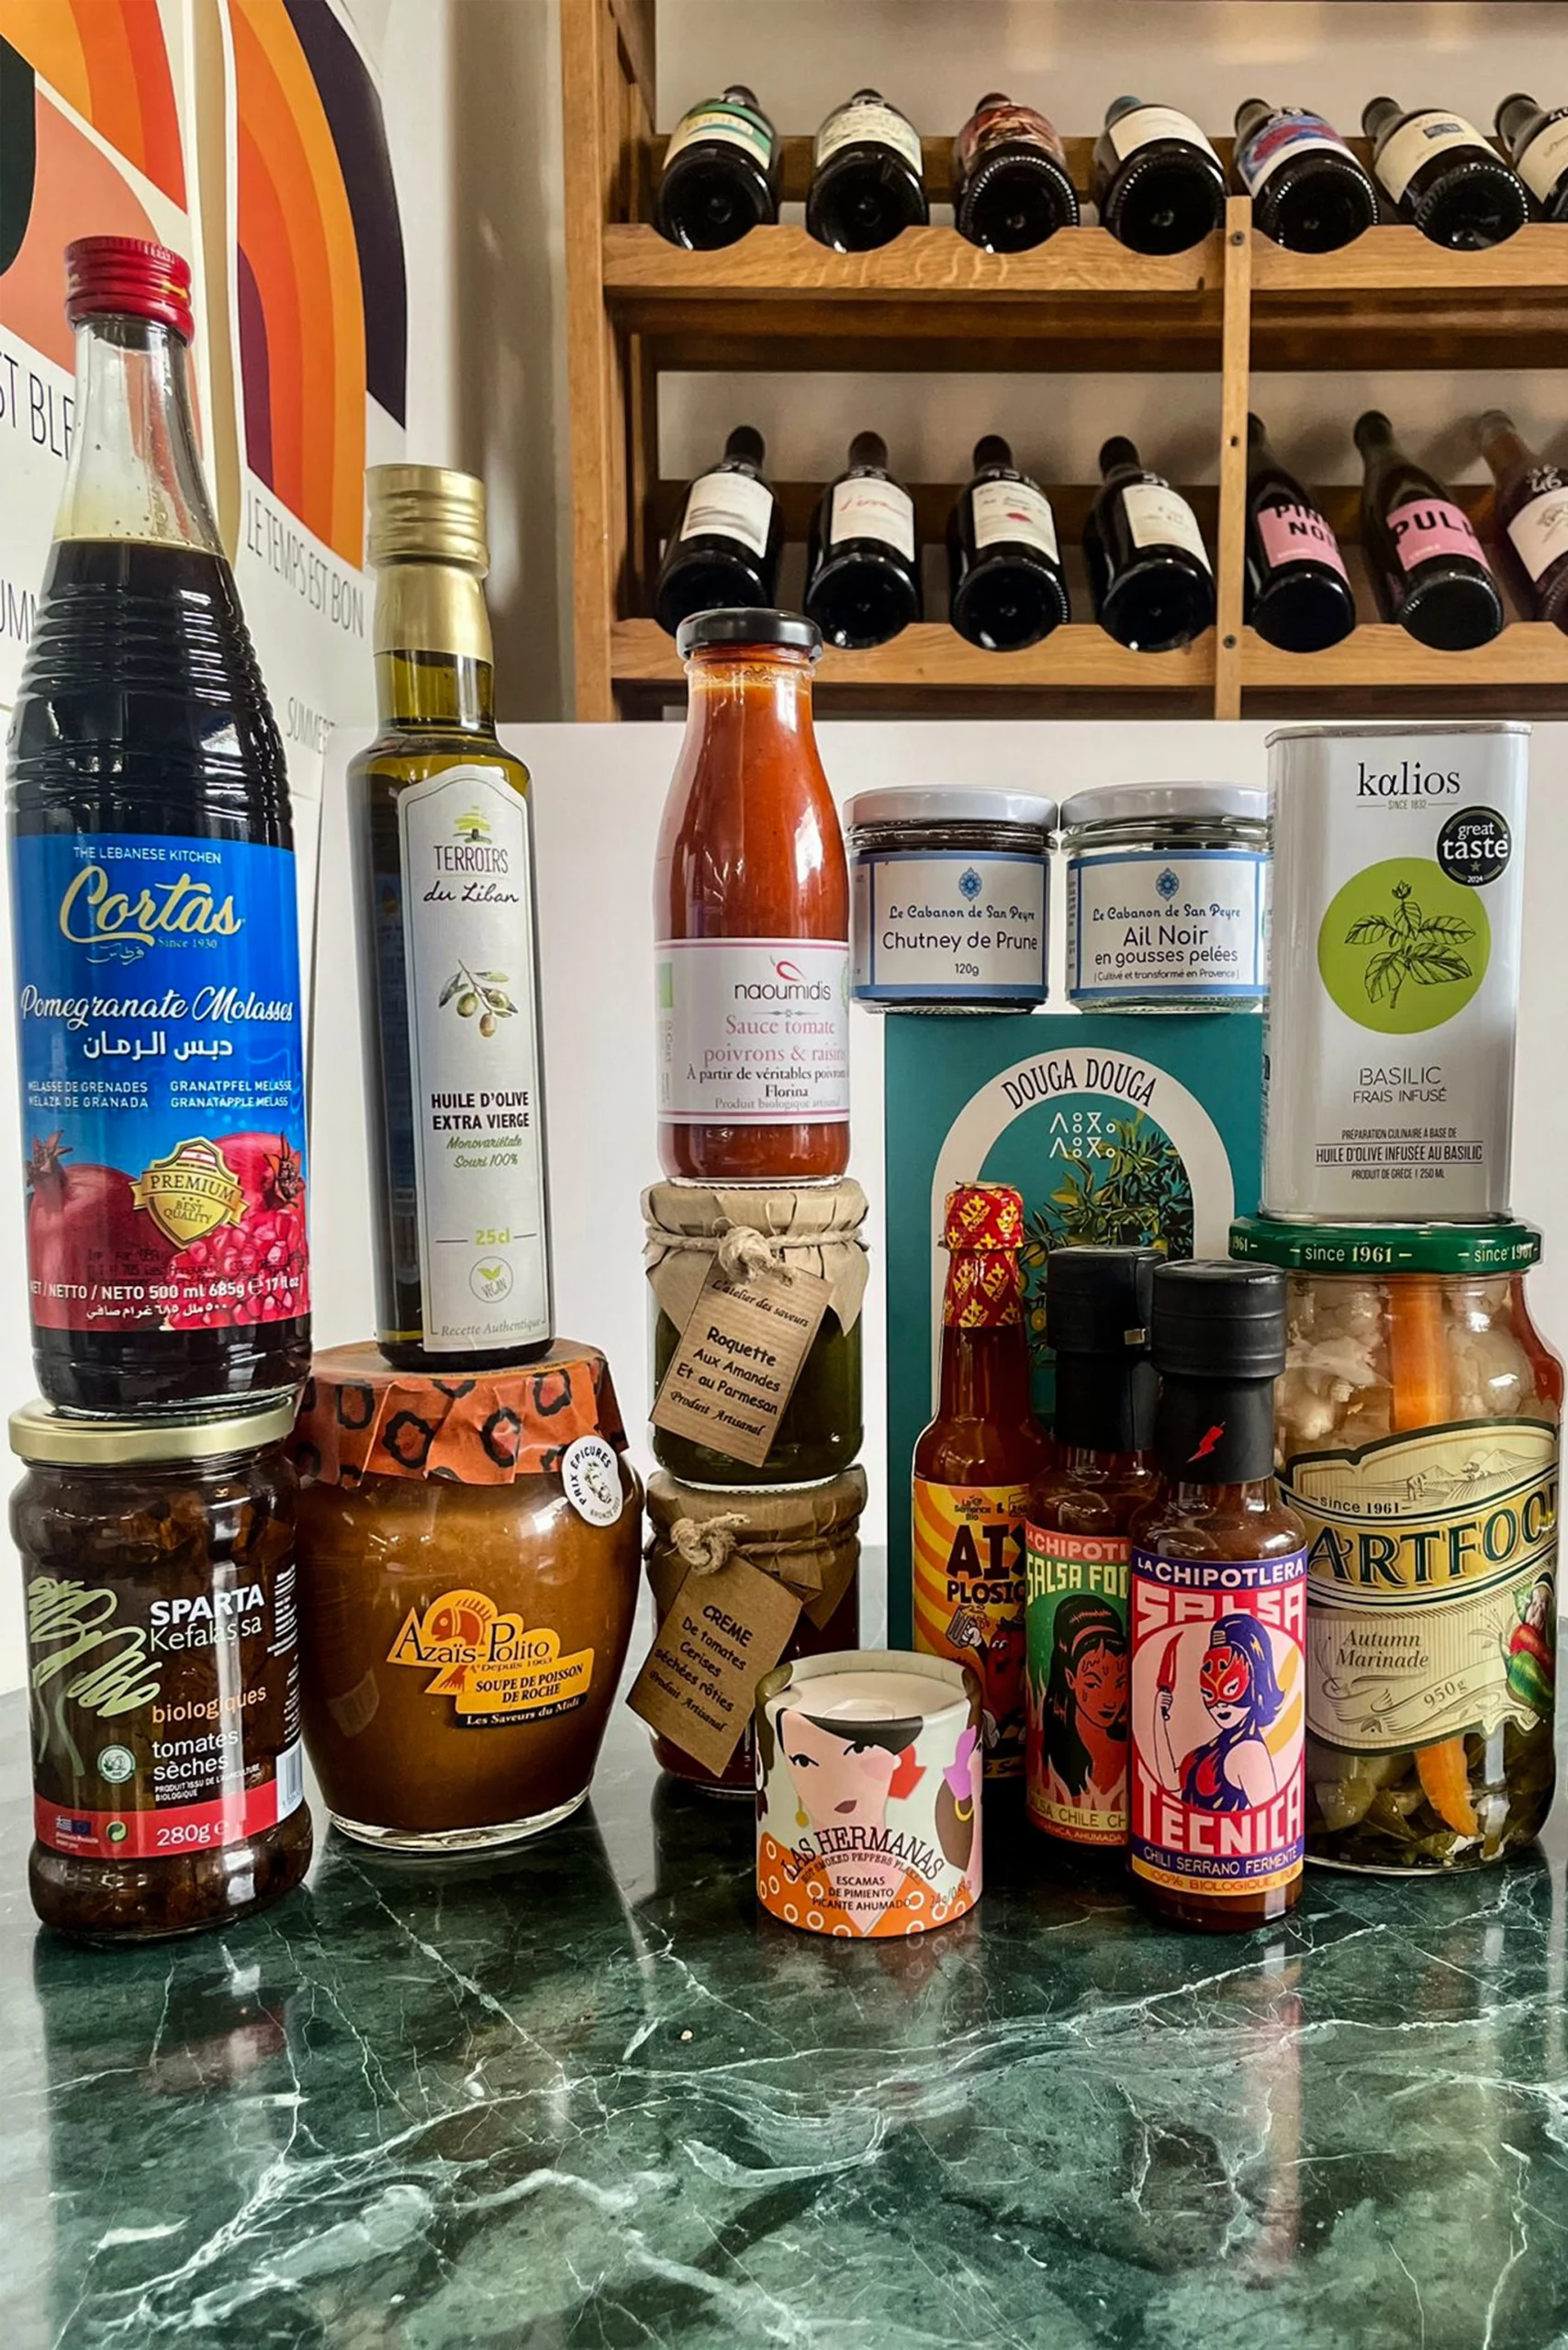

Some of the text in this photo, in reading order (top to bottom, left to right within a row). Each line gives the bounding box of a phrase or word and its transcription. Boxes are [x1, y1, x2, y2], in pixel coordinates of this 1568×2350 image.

[247, 489, 364, 638] LE TEMPS EST BON
[1387, 800, 1407, 810] SINCE
[1458, 822, 1495, 840] great
[73, 846, 221, 865] THE LEBANESE KITCHEN
[1442, 835, 1508, 860] taste
[433, 845, 509, 874] TERROIRS
[423, 880, 520, 903] du Liban
[60, 865, 242, 946] Cortas
[890, 905, 1007, 919] Le Cabanon de San
[1107, 903, 1206, 920] Cabanon de San
[158, 937, 217, 949] Since 1930
[883, 931, 1037, 953] Chutney de Prune
[1123, 925, 1209, 946] Ail Noir
[1094, 946, 1238, 968] en gousses pelées
[955, 963, 980, 977] 120g
[1125, 969, 1197, 979] et en
[734, 981, 832, 1001] naoumidis
[21, 984, 294, 1030] Pomegranate Molasses
[725, 1014, 835, 1035] Sauce tomate
[84, 1031, 233, 1061] دبس الرمان
[704, 1043, 805, 1068] poivrons &
[700, 1066, 812, 1083] partir de véritables
[1001, 1058, 1157, 1110] DOUGA DOUGA
[1359, 1067, 1442, 1086] BASILIC
[65, 1080, 148, 1093] DE GRENADES
[170, 1080, 292, 1091] GRANATPFEL MELASSE
[765, 1084, 809, 1098] Florina
[1352, 1087, 1448, 1103] FRAIS INFUSÉ
[64, 1096, 149, 1108] DE GRANADA
[171, 1097, 254, 1108] GRANATAPPLE
[431, 1091, 529, 1109] HUILE D'OLIVE
[432, 1113, 530, 1131] EXTRA VIERGE
[1341, 1127, 1446, 1140] PRÉPARATION BASE
[454, 1153, 518, 1168] Souri 100%
[1316, 1144, 1483, 1163] HUILE D'OLIVE INFUSÉE AU BASILIC
[1382, 1169, 1434, 1179] DE 250
[151, 1174, 235, 1203] PREMIUM
[163, 1207, 212, 1225] QUALITY
[175, 1201, 204, 1213] BEST
[1305, 1246, 1393, 1264] since 1961
[1474, 1246, 1508, 1263] since
[49, 1281, 245, 1300] NETTO NETO 500 ml 685g
[481, 1278, 508, 1298] VEGAN
[756, 1297, 810, 1327] des saveurs
[442, 1325, 481, 1337] Recette
[706, 1326, 778, 1367] Roquette
[693, 1348, 781, 1393] Aux Amandes
[676, 1362, 778, 1416] Et au Parmesan
[670, 1391, 767, 1437] Produit Artisanal
[570, 1445, 612, 1505] PRIX EPICURES
[1319, 1495, 1400, 1516] since 1961
[1026, 1552, 1082, 1606] SALSA
[1137, 1558, 1304, 1588] LA CHIPOTLERA
[150, 1584, 264, 1626] SPARTA
[1137, 1580, 1305, 1641] SALSA
[151, 1616, 263, 1652] Kefalas sa
[702, 1605, 753, 1648] CREME
[396, 1621, 550, 1663] Azaïs-Polito
[682, 1617, 747, 1672] De tomates
[1342, 1629, 1421, 1647] Autumn
[679, 1641, 722, 1678] Cerises
[1336, 1648, 1429, 1668] Marinade
[476, 1663, 584, 1693] SOUPE DE POISSON
[502, 1683, 561, 1703] DE ROCHE
[700, 1682, 734, 1714] rôties
[1423, 1678, 1469, 1709] 950g
[151, 1685, 266, 1724] biologiques
[466, 1696, 579, 1725] Les Saveurs du Midi
[680, 1698, 728, 1733] Artisanal
[151, 1730, 239, 1759] tomates
[152, 1755, 230, 1783] sèches
[205, 1776, 215, 1786] DE
[1058, 1808, 1099, 1827] CHILE
[156, 1823, 211, 1847] 280g
[781, 1826, 945, 1882] LAS HERMANAS
[851, 1852, 892, 1865] PEPPERS
[1144, 1846, 1170, 1868] CHILI
[1177, 1856, 1239, 1875] SERRANO
[836, 1875, 885, 1886] ESCAMAS
[812, 1897, 911, 1910] PICANTE AHUMADO
[828, 1887, 894, 1899] DE PIMIENTO
